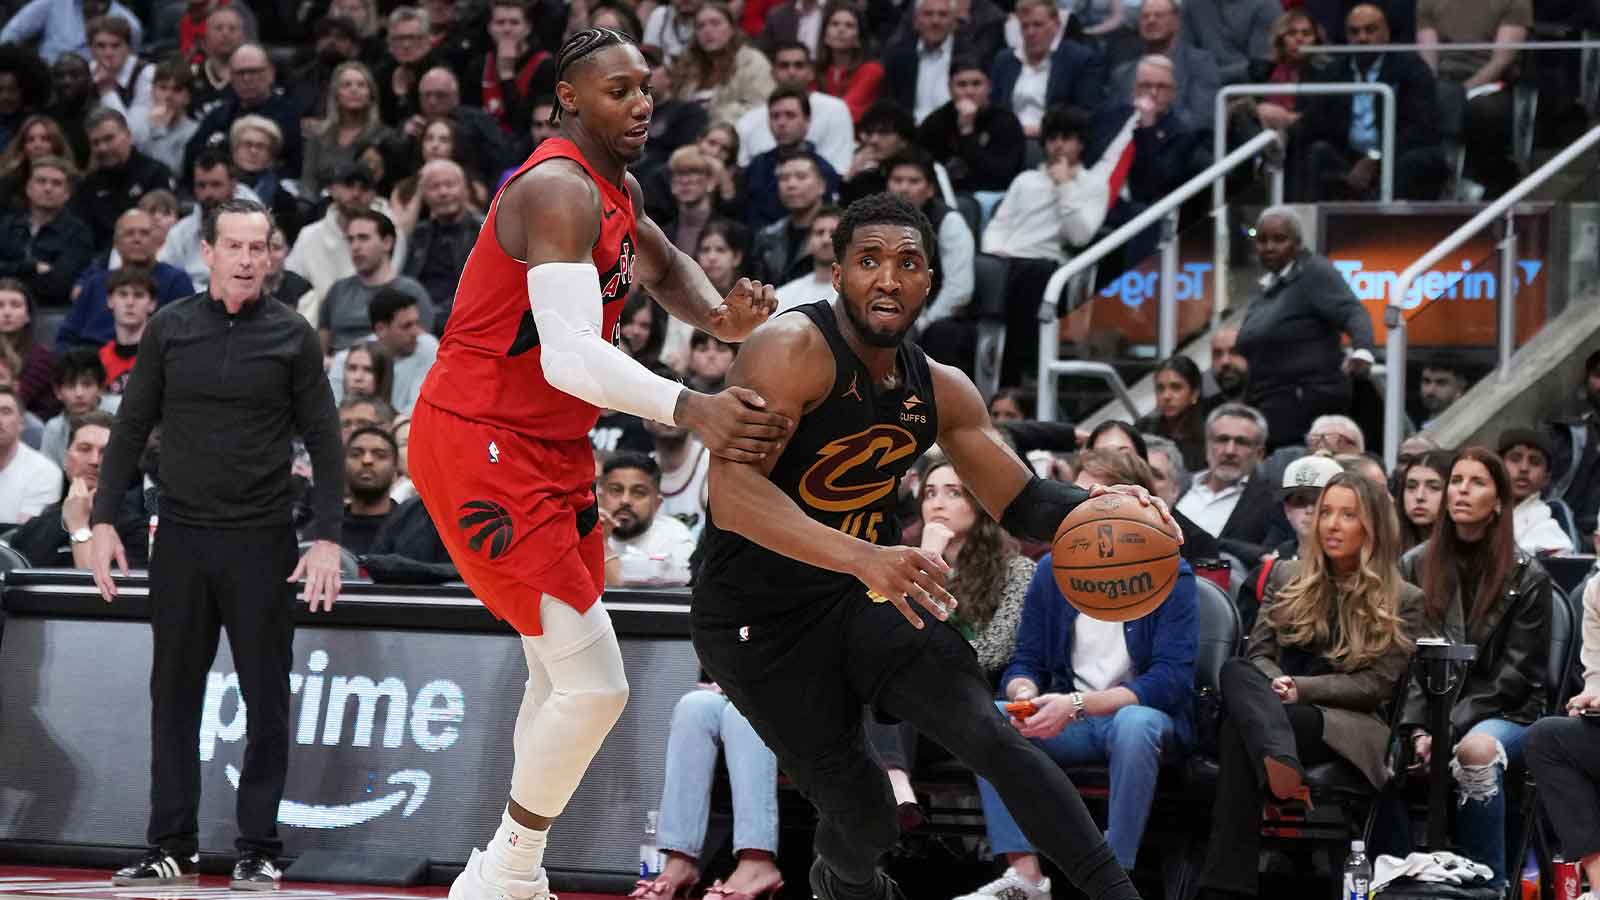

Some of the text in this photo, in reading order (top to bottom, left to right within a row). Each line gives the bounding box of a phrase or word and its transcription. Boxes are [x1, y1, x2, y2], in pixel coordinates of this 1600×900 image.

[1332, 259, 1520, 310] Tangerin
[1069, 571, 1153, 600] Wilson
[199, 649, 465, 762] pime
